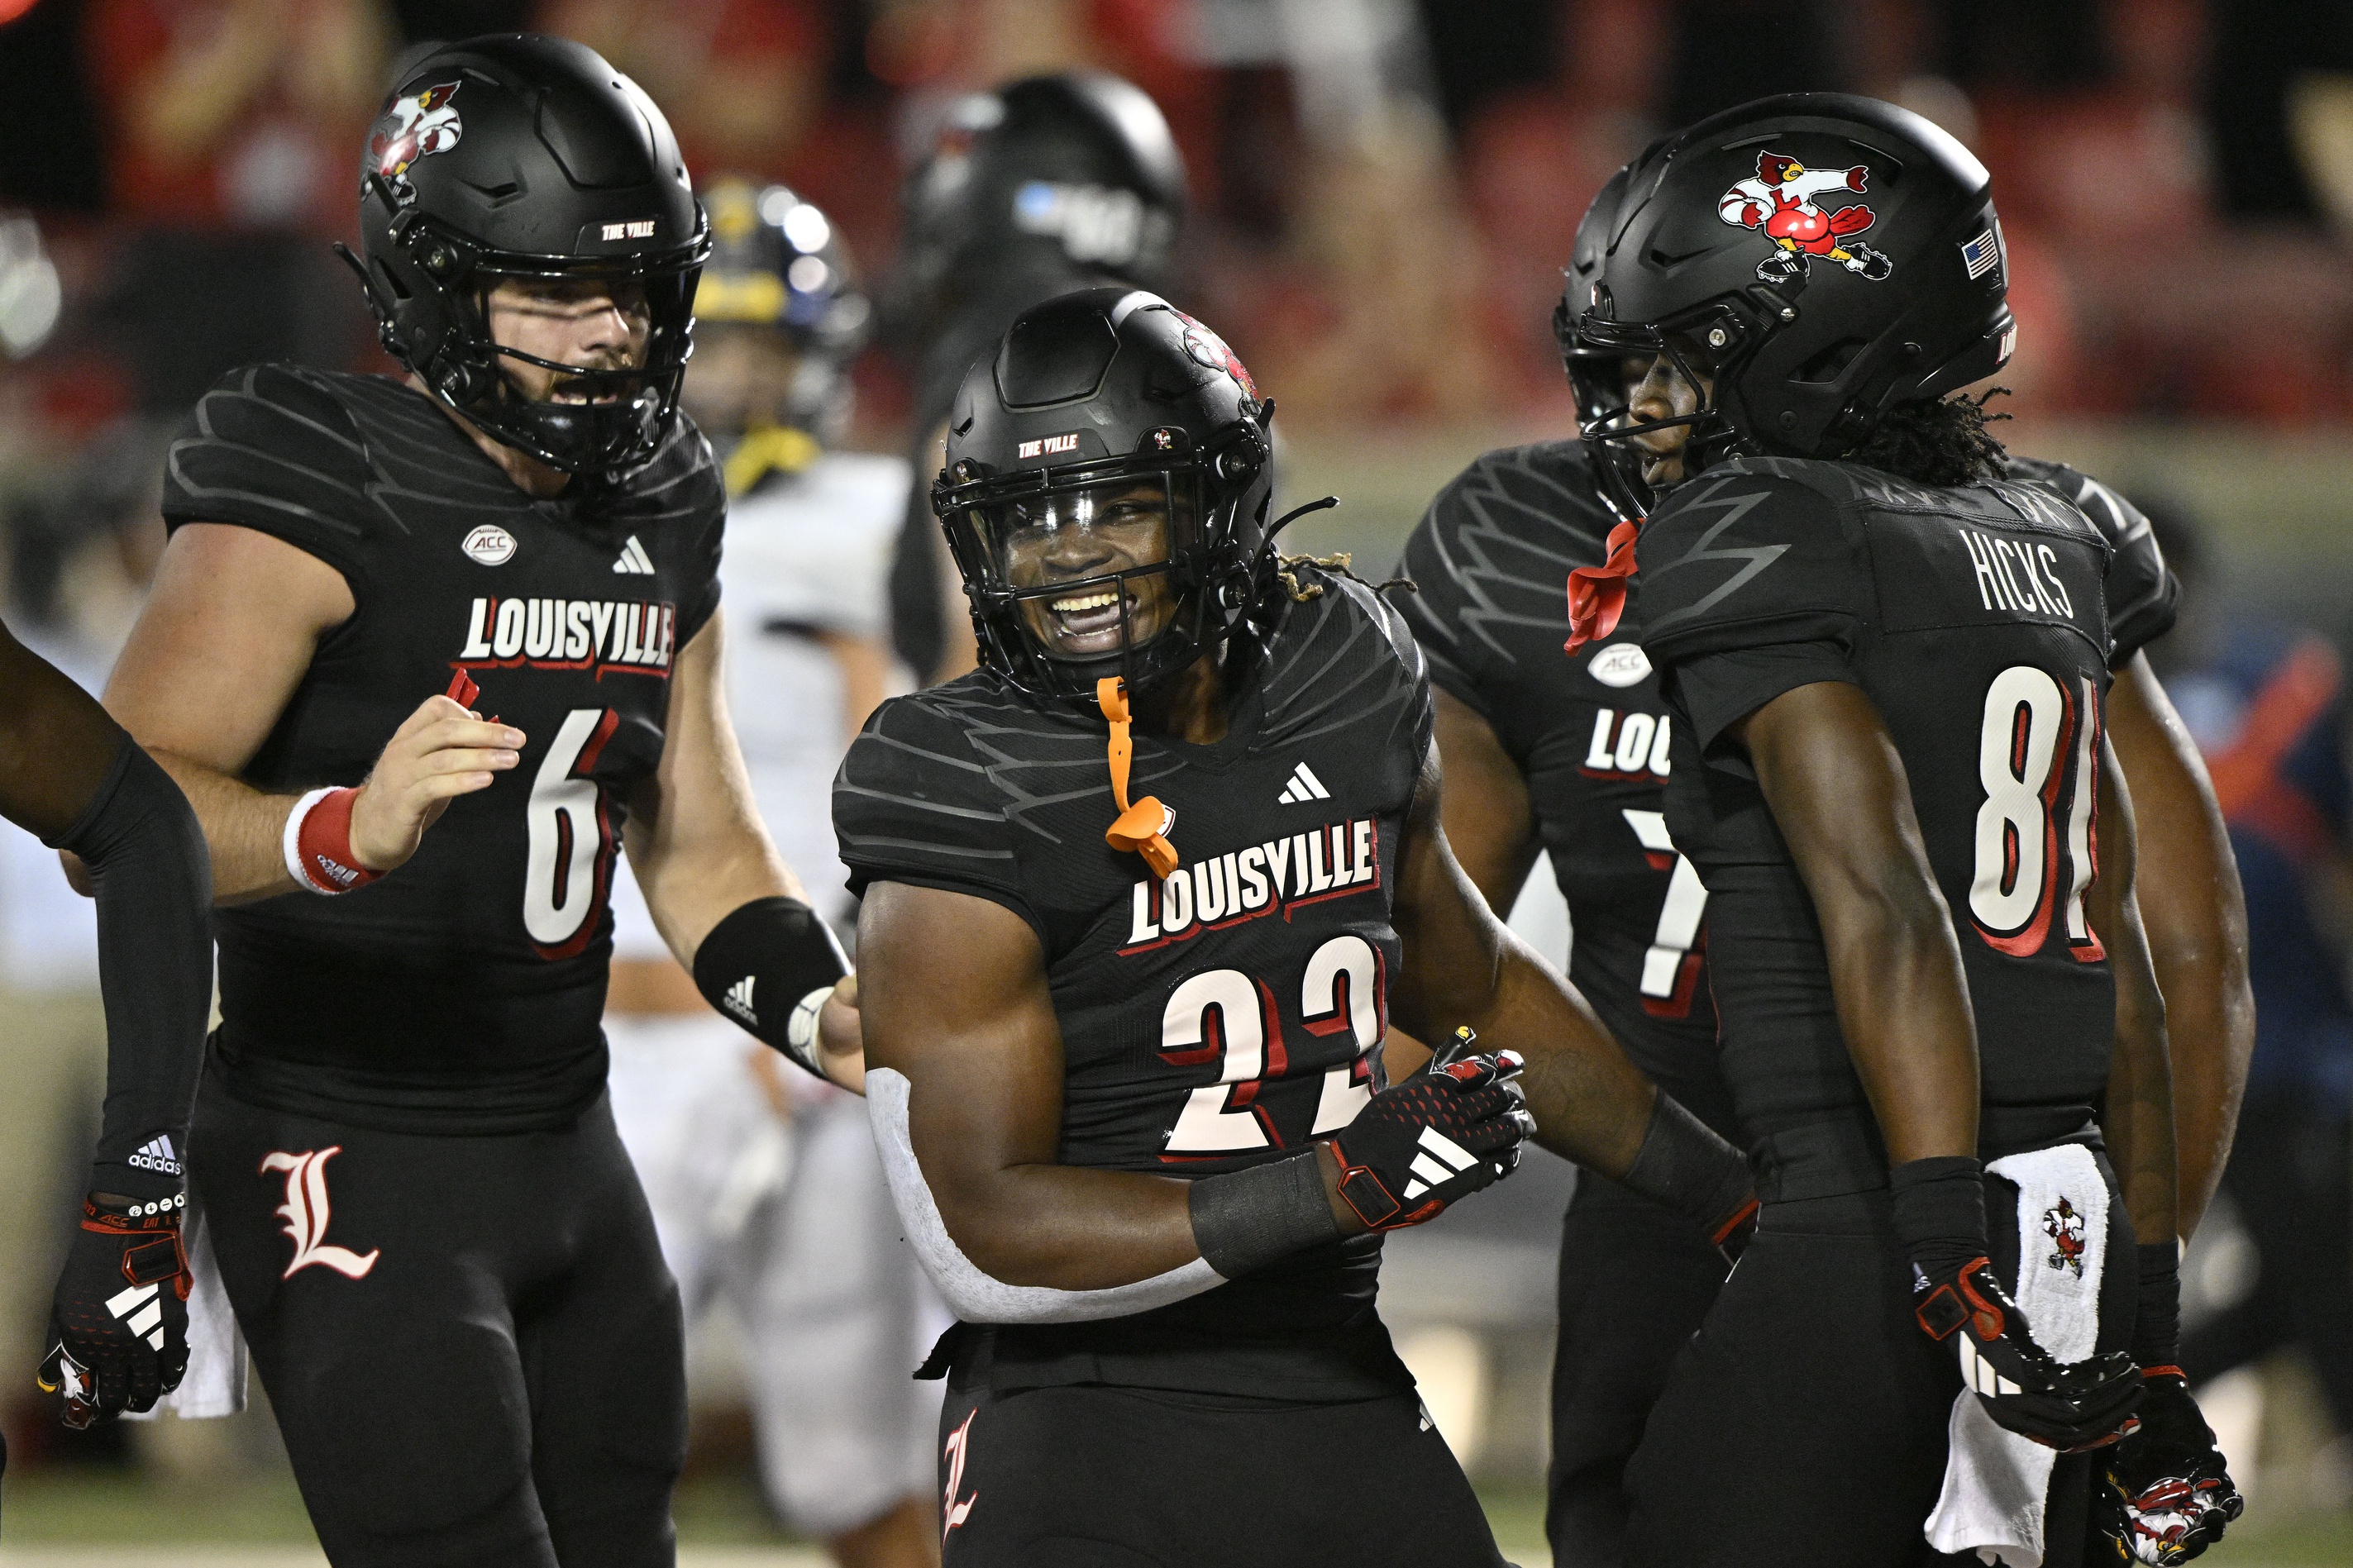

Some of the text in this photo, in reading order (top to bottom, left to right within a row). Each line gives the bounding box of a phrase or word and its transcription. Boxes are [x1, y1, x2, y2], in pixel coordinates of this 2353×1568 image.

[602, 221, 655, 241] THE VILLE
[1019, 434, 1078, 460] THE VILLE
[474, 536, 506, 550] ACC
[1959, 529, 2074, 619] HICKS
[457, 597, 674, 668] LOUISVILLE
[1602, 654, 1643, 671] ACC
[523, 708, 600, 946] 6
[1969, 665, 2097, 946] 81
[1125, 818, 1374, 947] LOUISVILLE
[1162, 935, 1378, 1151] 22
[128, 1154, 181, 1175] adidas
[257, 1145, 380, 1280] L
